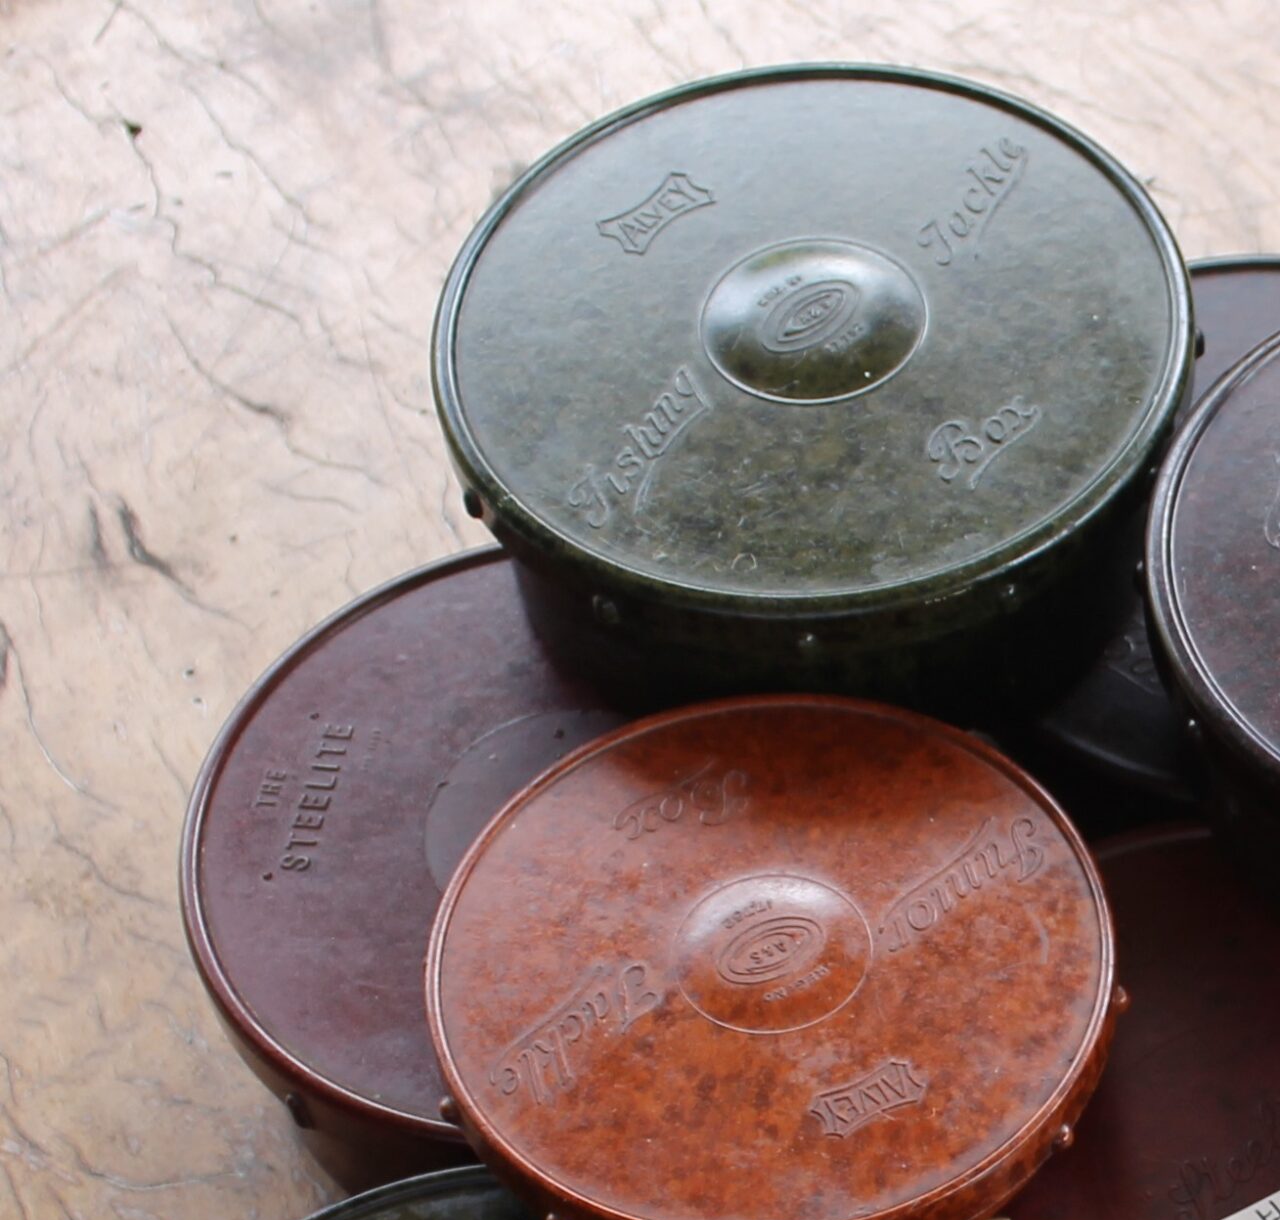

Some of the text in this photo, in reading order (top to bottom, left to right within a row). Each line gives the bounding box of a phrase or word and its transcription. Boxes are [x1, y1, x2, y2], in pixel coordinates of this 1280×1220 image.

[617, 176, 693, 249] ALVEY
[915, 137, 1028, 267] Tackle
[566, 363, 712, 529] Fishing
[927, 395, 1043, 486] Box
[253, 767, 288, 809] THE
[279, 723, 356, 873] STEELITE
[611, 768, 749, 841] Box
[880, 816, 1047, 953] Junior
[488, 962, 663, 1107] Tackle
[816, 1062, 924, 1132] ALVEY
